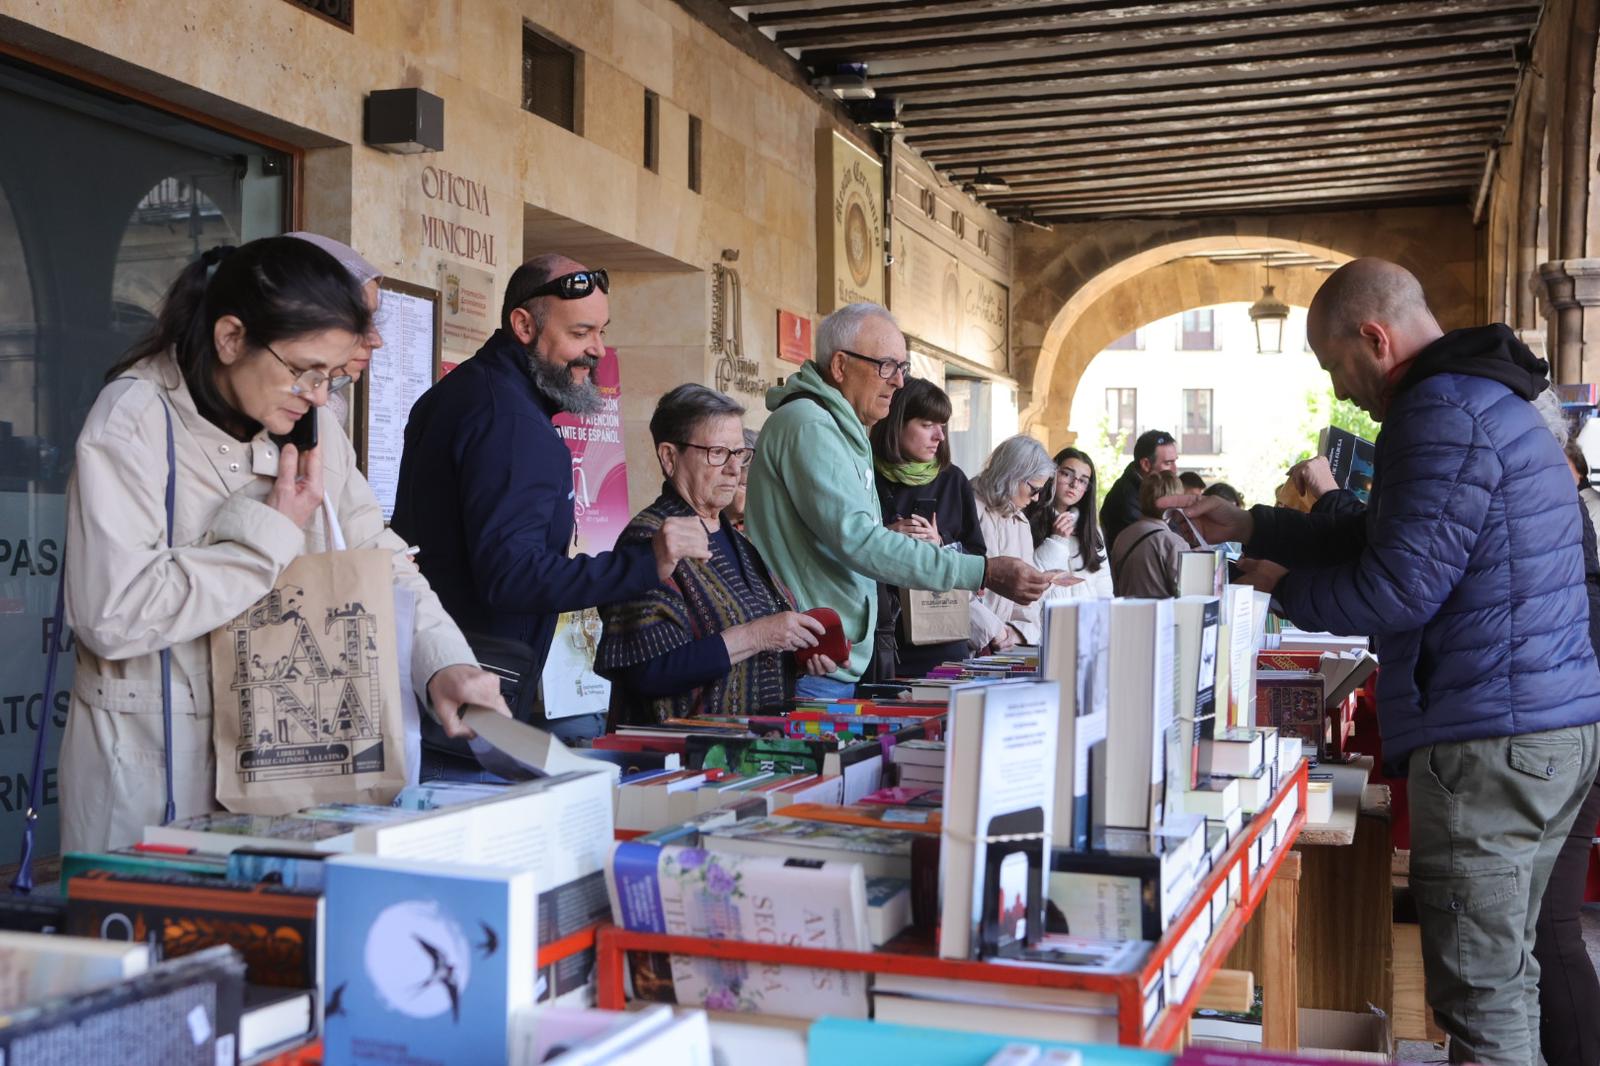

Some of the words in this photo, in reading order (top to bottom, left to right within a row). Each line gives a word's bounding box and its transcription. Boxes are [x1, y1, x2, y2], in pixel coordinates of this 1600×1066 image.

[421, 165, 490, 217] OFICINA
[421, 213, 497, 267] MUNICIPAL
[578, 427, 587, 441] DE
[587, 427, 621, 443] ESPAÑOL
[0, 690, 71, 735] TOS
[663, 896, 693, 983] TIERA
[802, 908, 833, 991] ANES
